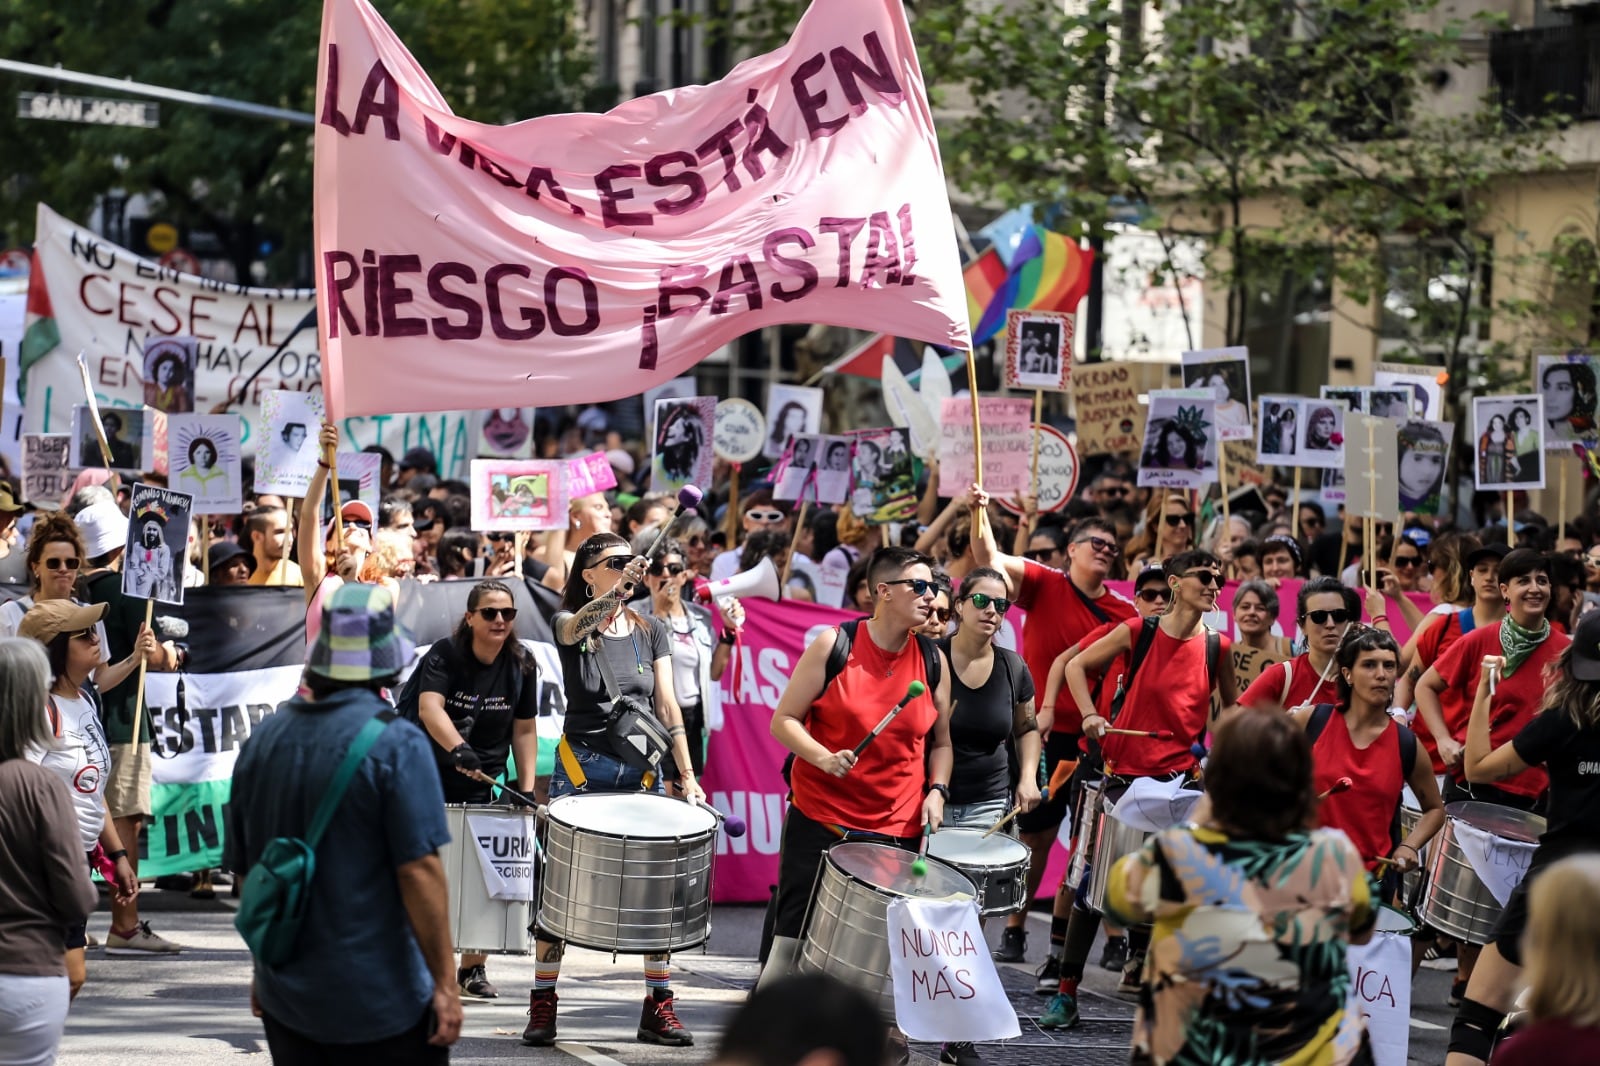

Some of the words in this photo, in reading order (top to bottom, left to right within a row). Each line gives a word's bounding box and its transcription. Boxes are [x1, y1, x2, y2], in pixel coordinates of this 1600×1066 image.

[31, 96, 82, 120] SAN
[84, 101, 146, 125] JOSE
[320, 43, 401, 141] LA
[594, 88, 790, 229] ESTÁ
[791, 30, 905, 142] EN
[79, 274, 219, 342] CESE
[233, 303, 285, 348] AL
[196, 342, 252, 373] HAY
[1073, 367, 1128, 388] VERDAD
[1075, 387, 1136, 405] MEMORIA
[1081, 404, 1138, 424] JUSTICIA
[1103, 421, 1112, 434] Y
[720, 646, 791, 710] AS
[1578, 761, 1600, 775] @MA
[138, 803, 232, 869] TIN
[712, 791, 791, 855] NU
[478, 836, 532, 858] FURIA
[901, 928, 977, 958] NUNCA
[912, 965, 976, 1003] MÁS
